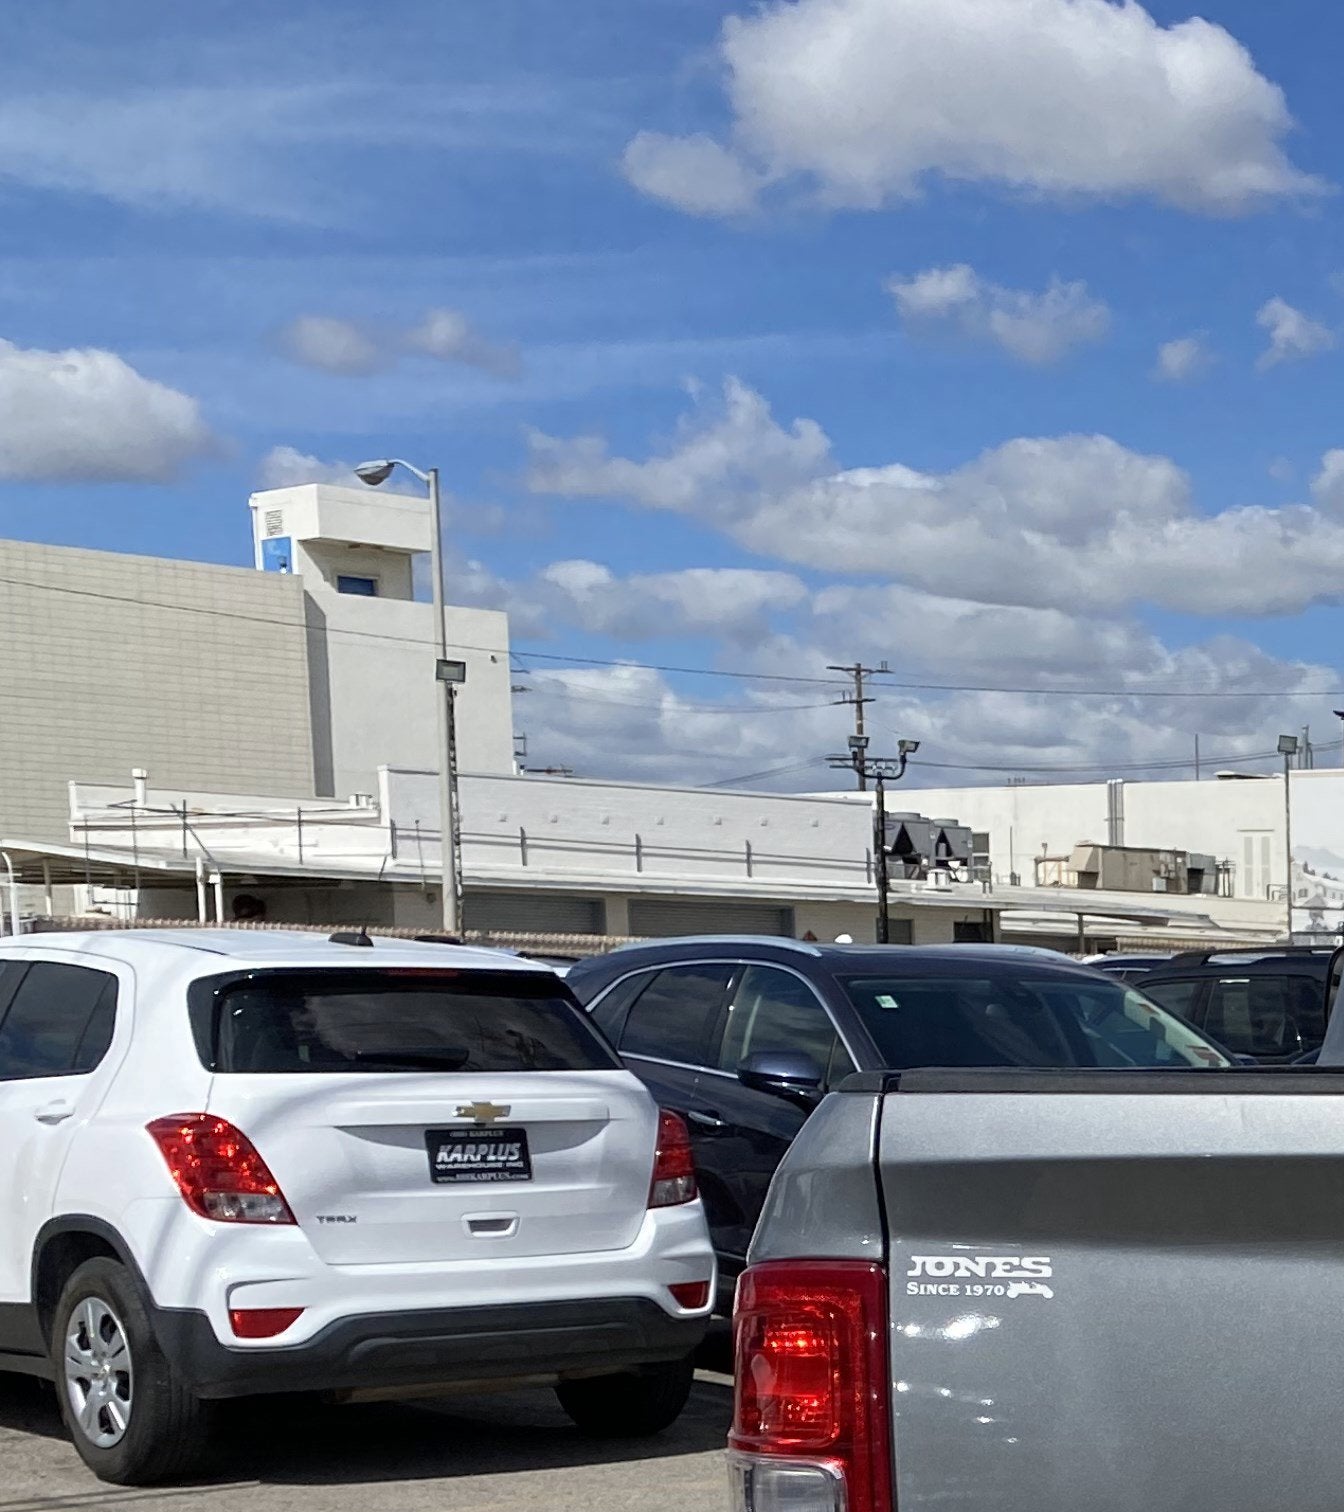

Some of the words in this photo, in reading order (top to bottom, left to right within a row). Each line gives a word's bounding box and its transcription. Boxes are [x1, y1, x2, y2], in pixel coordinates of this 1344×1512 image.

[437, 1143, 521, 1162] KARPLUS
[906, 1255, 1053, 1278] JONES
[965, 1284, 1005, 1296] 1970
